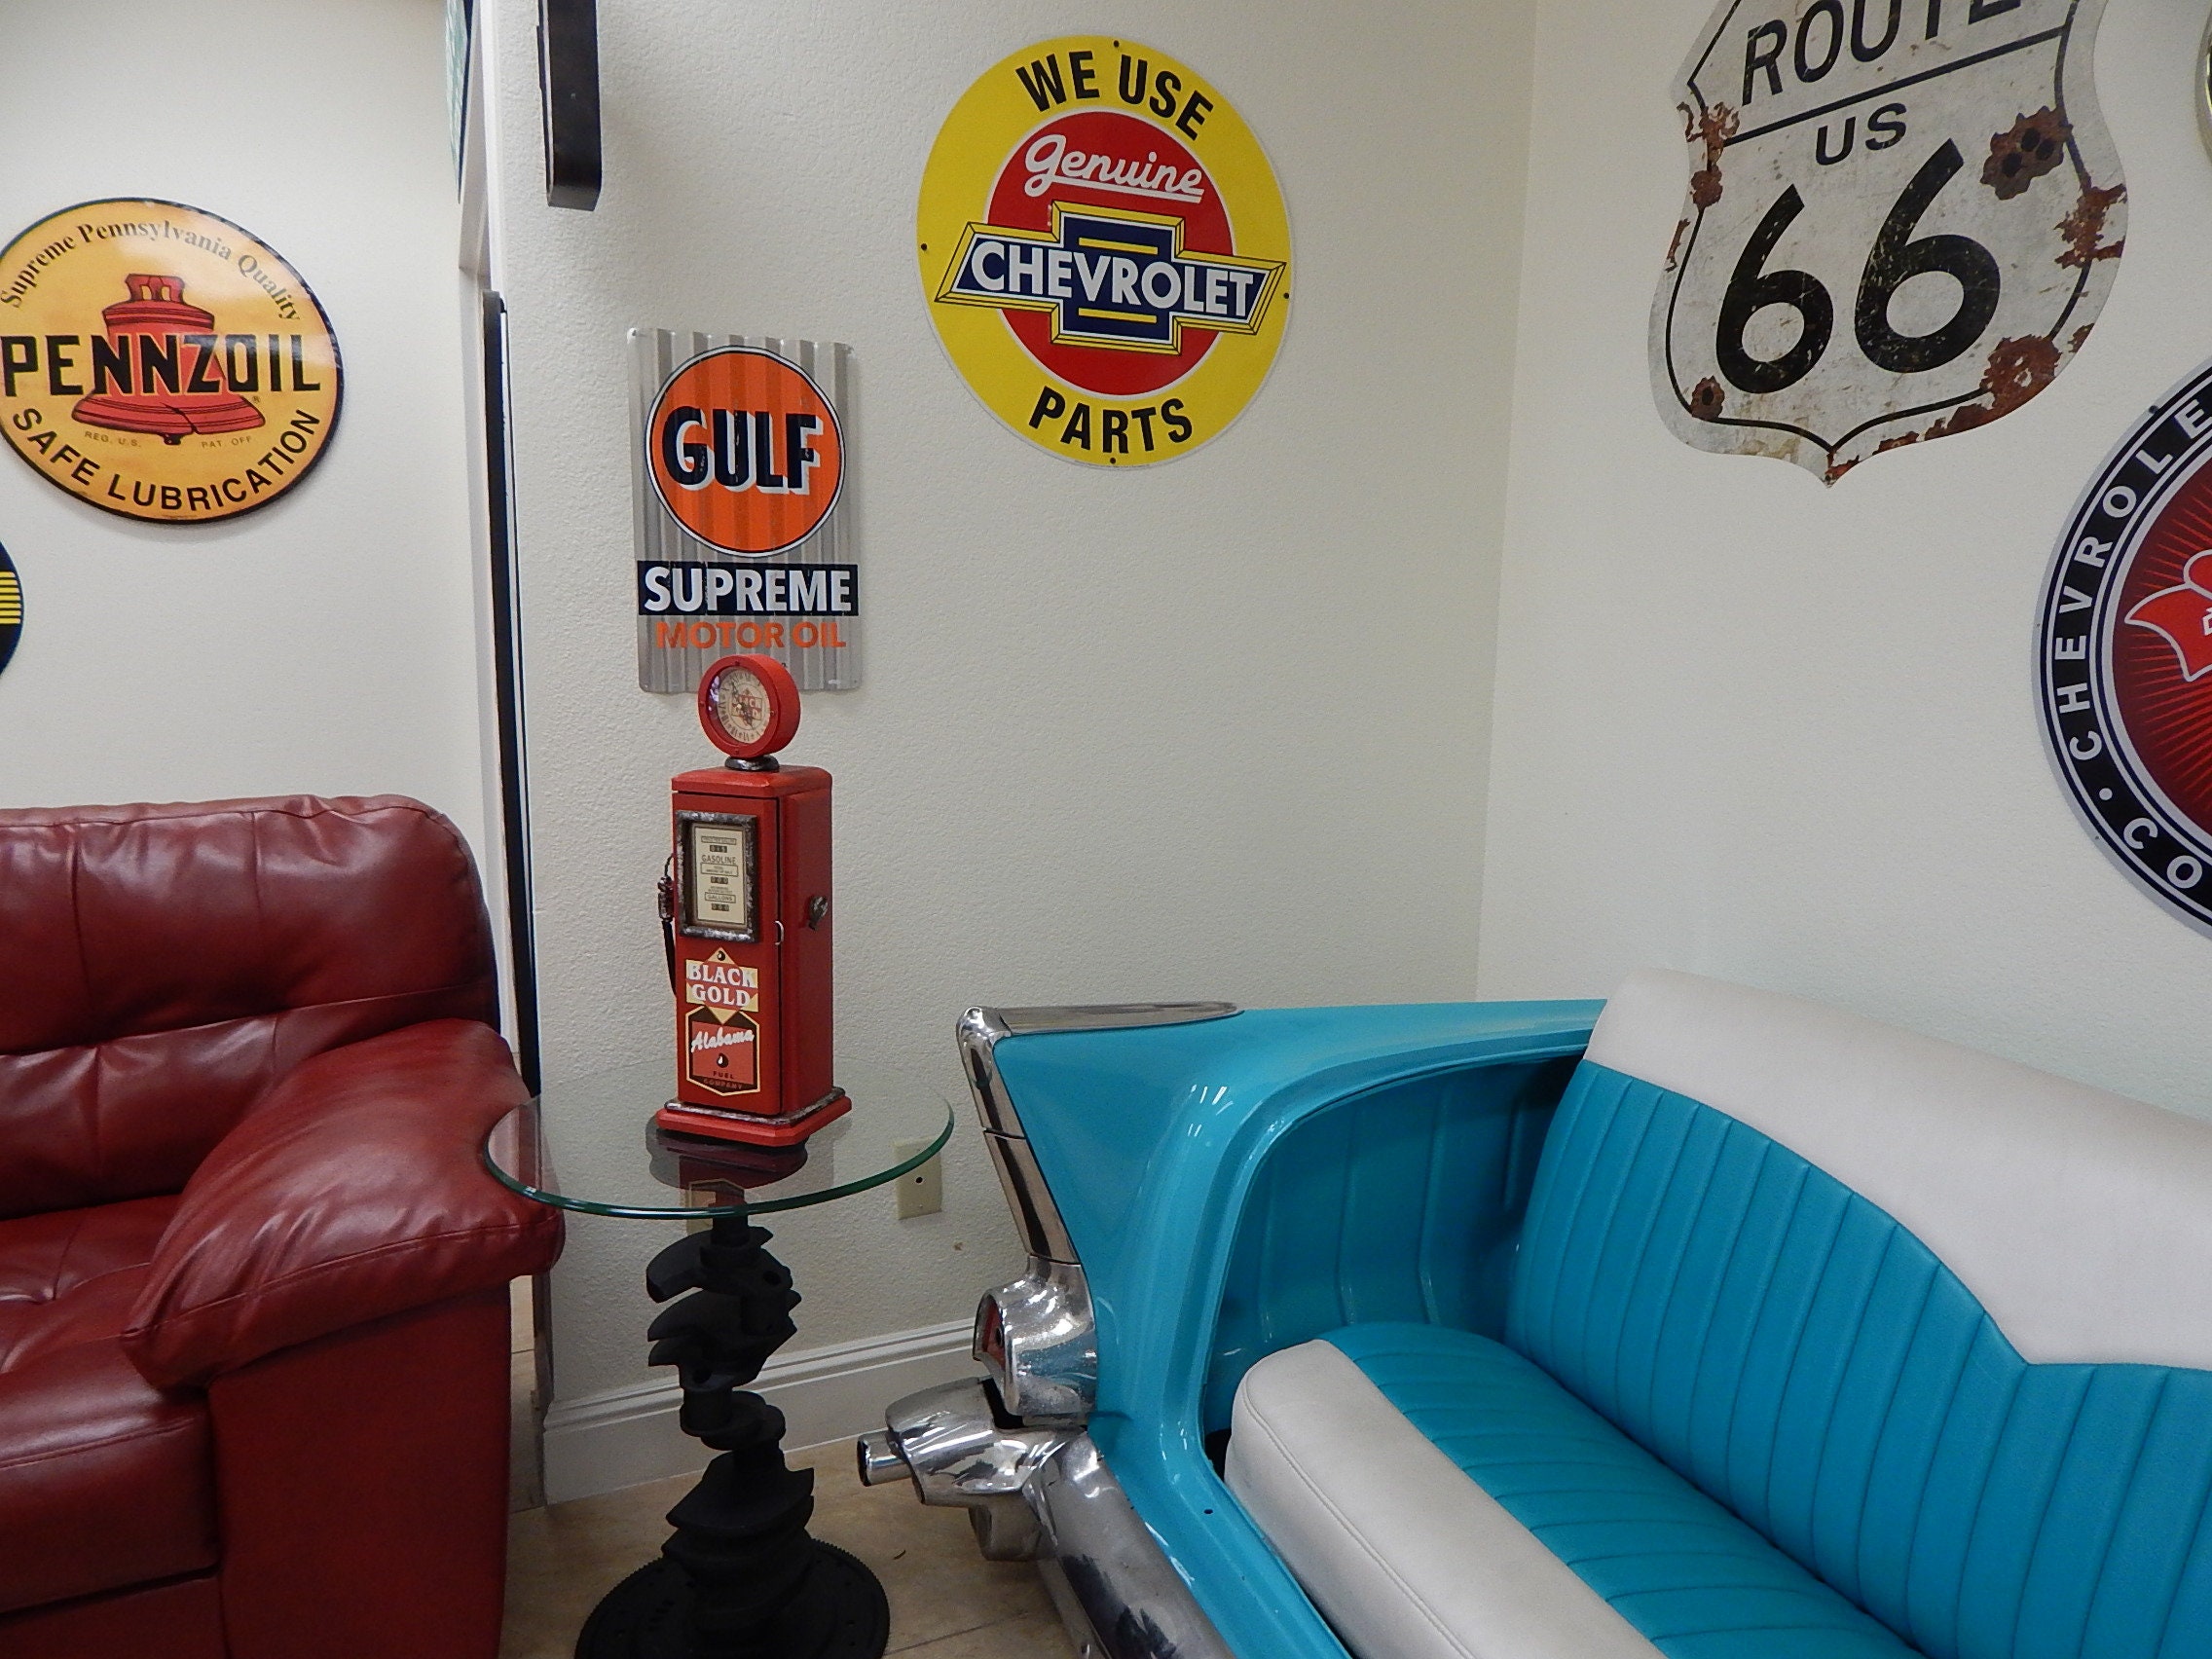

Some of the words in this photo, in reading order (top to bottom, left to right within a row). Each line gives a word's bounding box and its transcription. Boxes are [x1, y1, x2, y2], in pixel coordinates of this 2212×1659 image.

[1742, 0, 2021, 106] ROU
[1015, 51, 1100, 112] WE
[1118, 55, 1214, 141] USE
[1815, 103, 1907, 166] US
[1024, 134, 1205, 203] Genuine
[0, 236, 77, 309] Supreme
[77, 220, 232, 260] Pennsylvania
[238, 254, 301, 321] Quality
[971, 241, 1254, 317] CHEVROLET
[1715, 138, 2001, 394] 66
[0, 334, 321, 397] PENNZOIL
[662, 405, 824, 496] GULF
[1028, 386, 1194, 454] PARTS
[13, 408, 101, 486] SAFE
[107, 409, 321, 512] LUBRICATION
[644, 566, 852, 612] SUPREME
[655, 621, 785, 649] MOTOR
[792, 622, 846, 648] OIL
[701, 854, 736, 865] GASOLINE
[687, 963, 757, 988] BLACK
[691, 983, 751, 1007] GOLD
[690, 1026, 755, 1052] Alabama
[703, 1078, 743, 1089] COMPANY
[713, 1070, 734, 1080] FUEL
